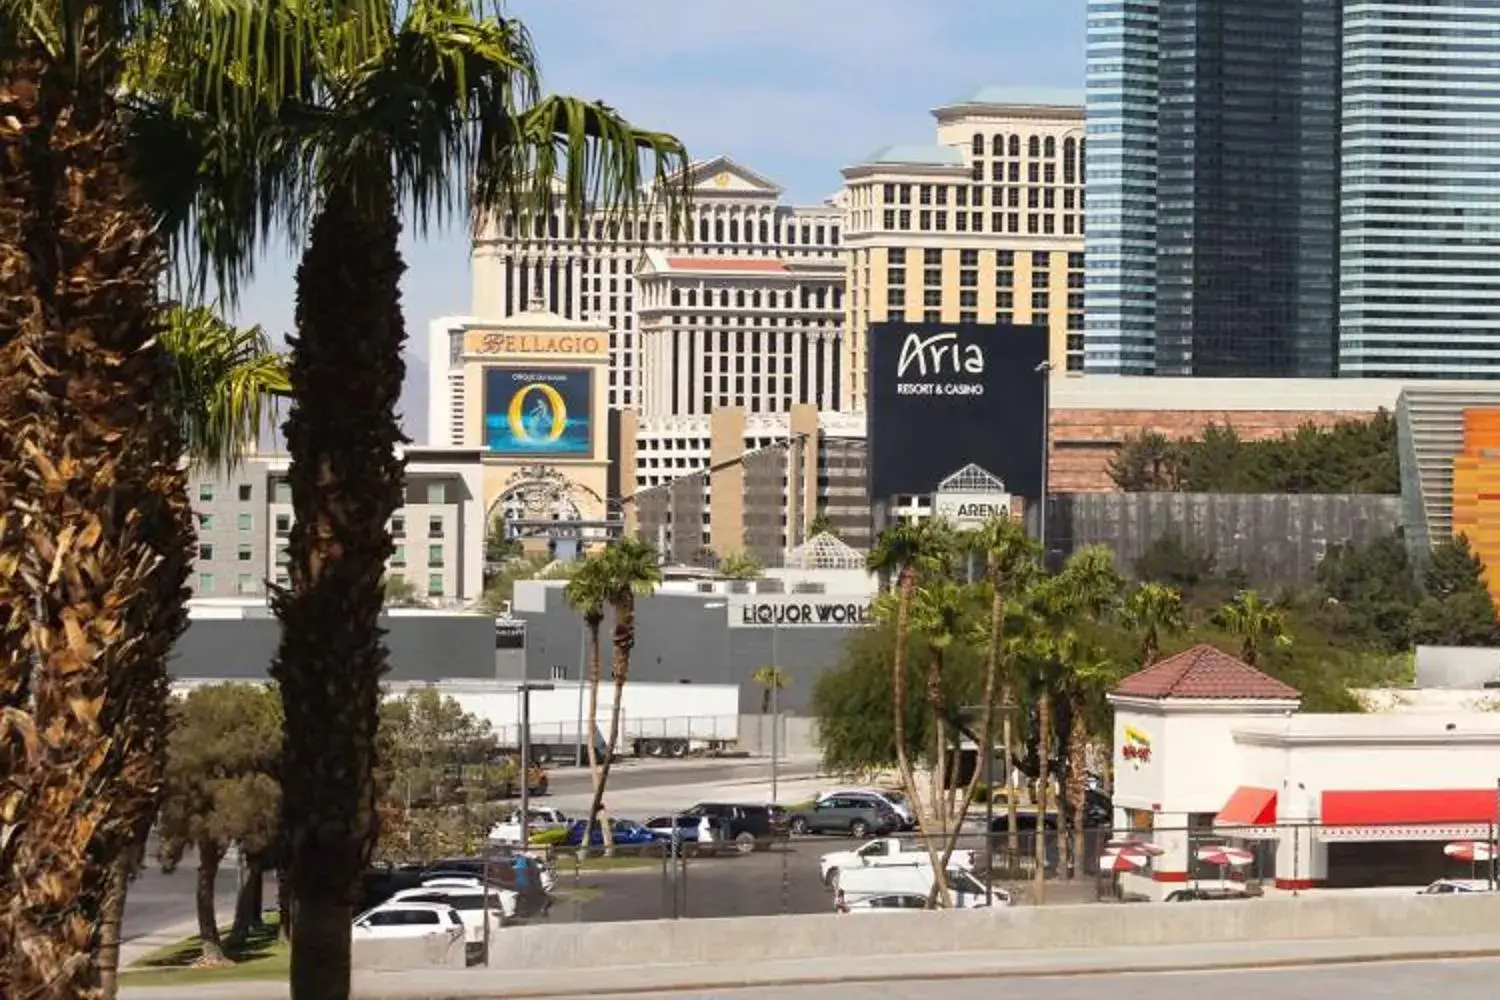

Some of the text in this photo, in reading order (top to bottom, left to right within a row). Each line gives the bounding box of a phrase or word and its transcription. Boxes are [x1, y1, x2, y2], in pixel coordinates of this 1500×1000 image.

[476, 333, 599, 353] BELLAGIO
[897, 332, 984, 377] Aria
[897, 383, 984, 395] RESORT & CASINO
[957, 503, 1009, 517] ARENA
[743, 604, 867, 623] LIQUOR WORL
